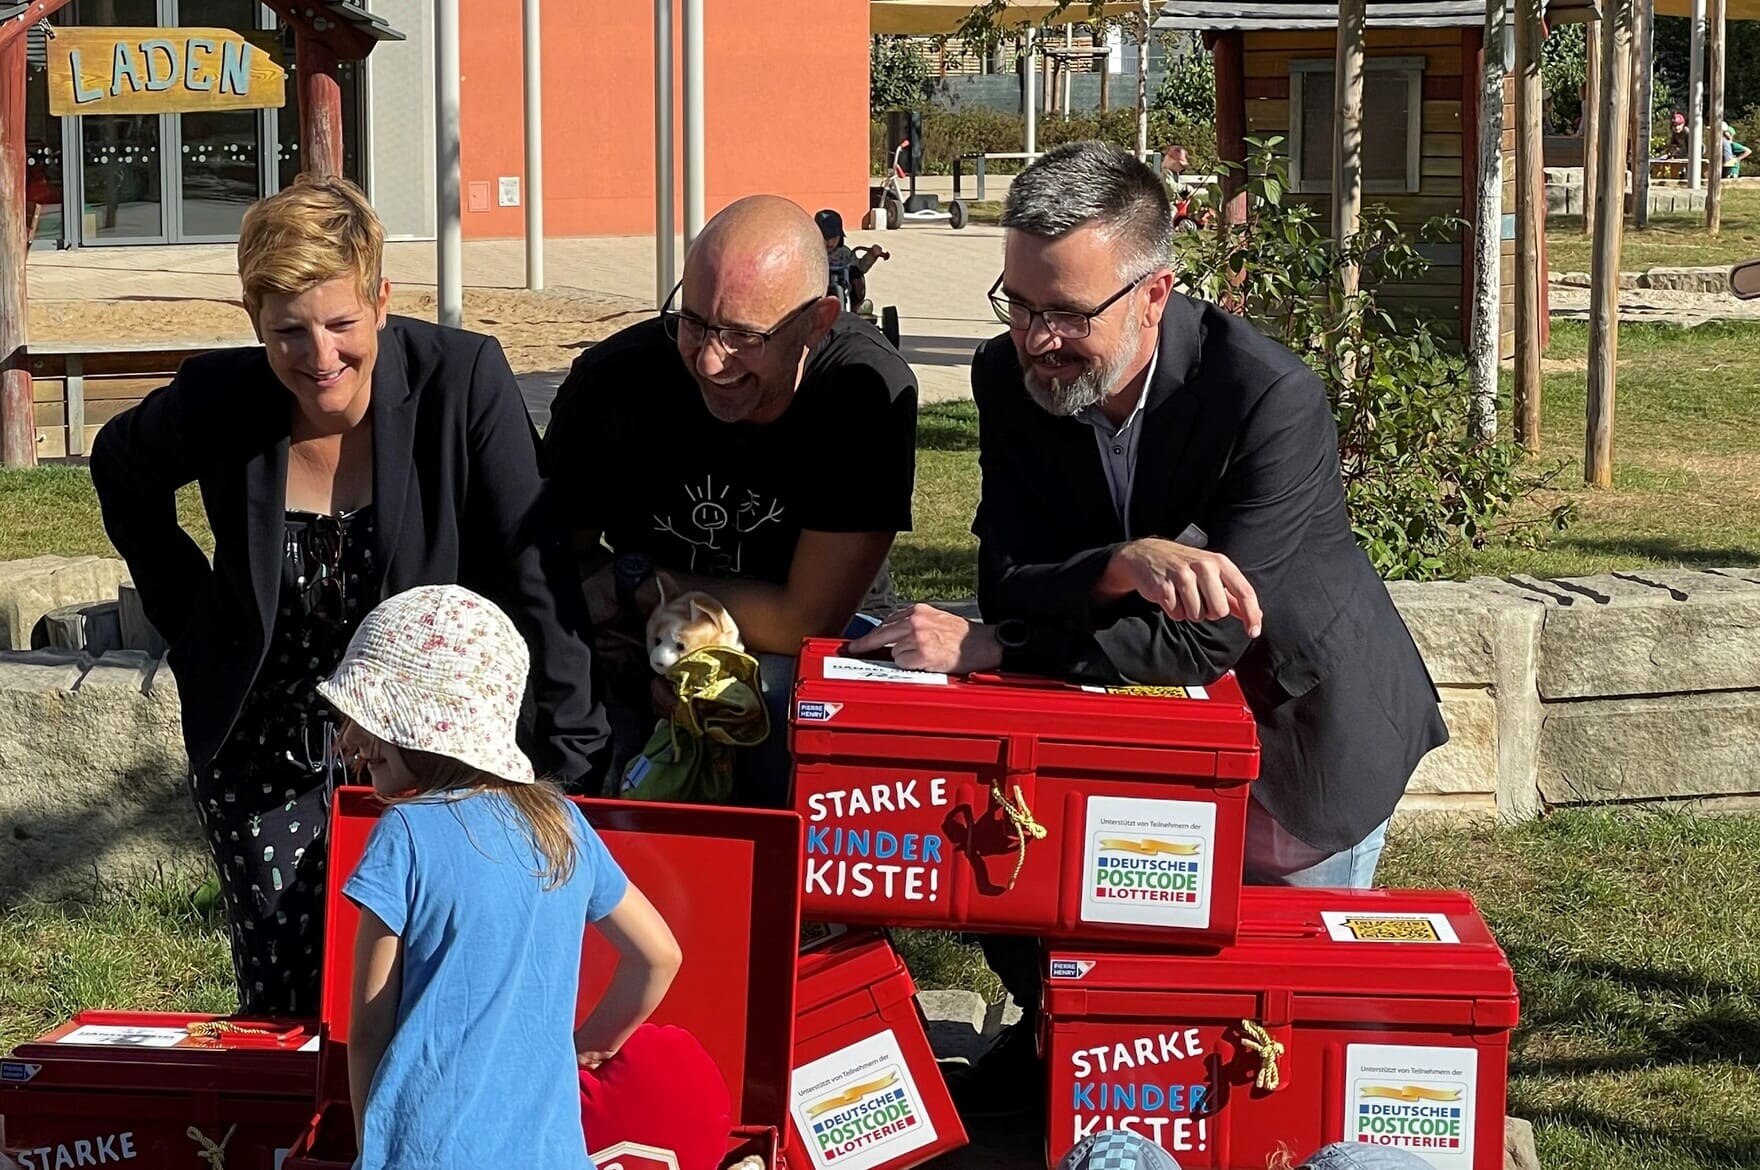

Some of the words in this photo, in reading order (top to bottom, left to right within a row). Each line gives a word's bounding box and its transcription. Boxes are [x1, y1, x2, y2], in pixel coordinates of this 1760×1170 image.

[69, 38, 253, 103] LADEN
[1100, 818, 1136, 828] Unterstützt
[1150, 821, 1189, 830] Teilnehmern
[807, 826, 942, 864] KINDER
[1110, 857, 1187, 872] DEUTSCHE
[805, 858, 938, 902] KISTE!
[1097, 868, 1197, 891] POSTCODE
[1108, 887, 1185, 902] LOTTERIE
[1072, 1028, 1203, 1078] STARKE
[832, 1073, 844, 1082] von
[879, 1054, 889, 1063] der
[1360, 1066, 1397, 1074] Unterstützt
[1411, 1067, 1451, 1076] Teilnehmern
[824, 1092, 895, 1130] DEUTSCHE
[1073, 1082, 1208, 1113] KINDER
[1371, 1104, 1449, 1118] DEUTSCHE
[817, 1098, 912, 1150] POSTCODE
[835, 1120, 906, 1156] LOTTERIE
[1358, 1116, 1460, 1137] POSTCODE
[17, 1132, 137, 1170] STARKE
[1370, 1134, 1448, 1148] LOTTERIE
